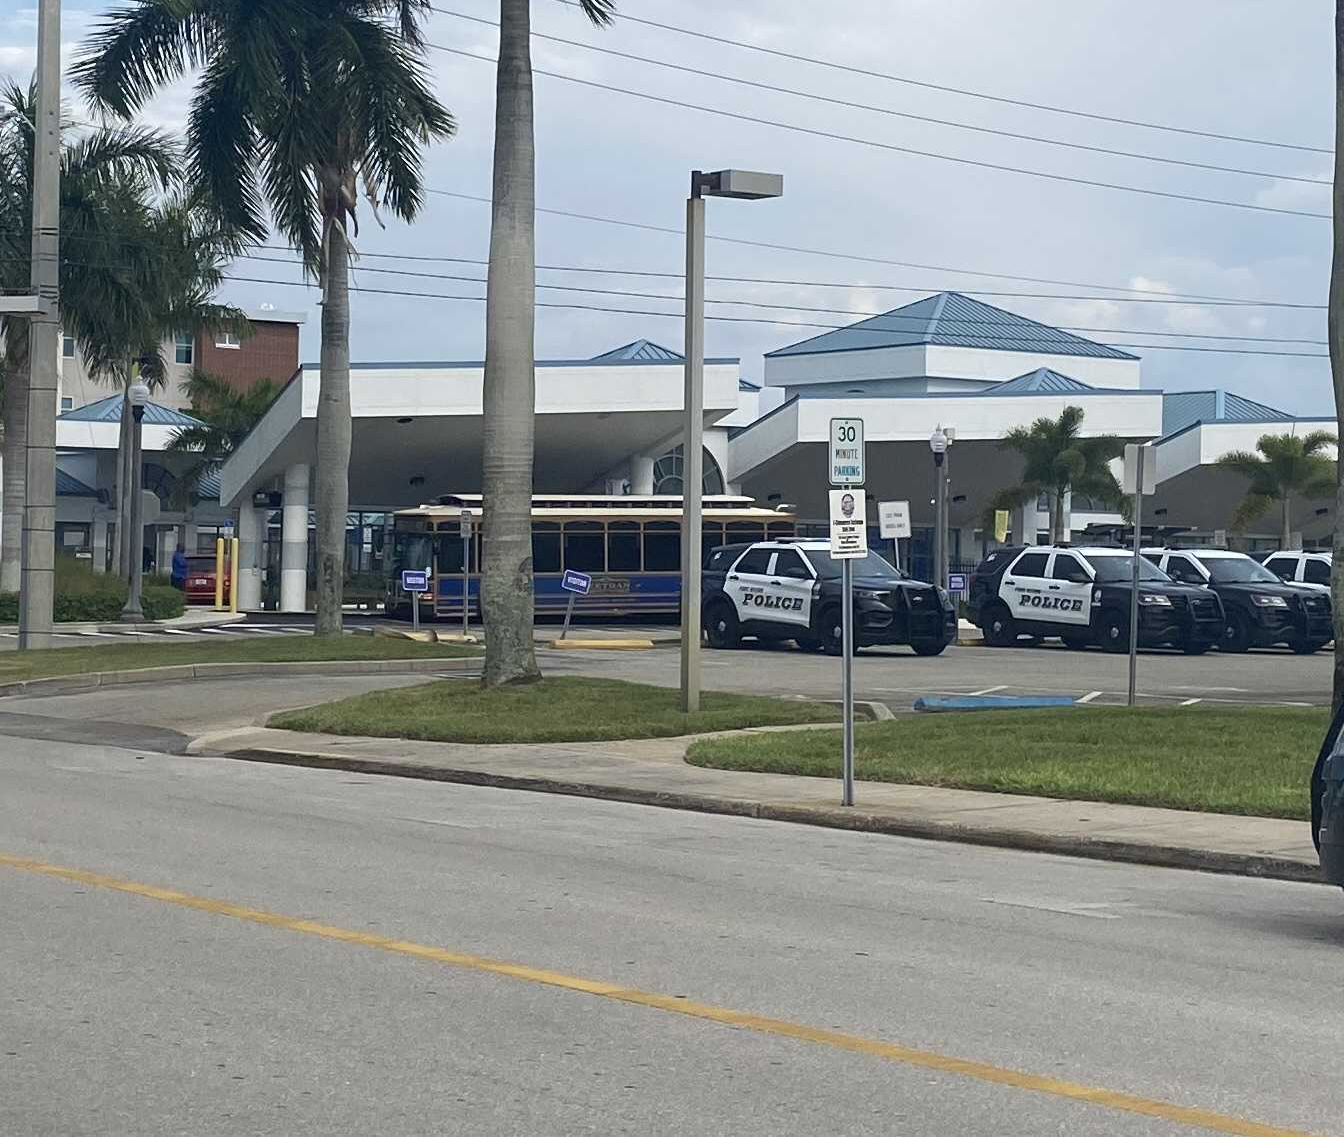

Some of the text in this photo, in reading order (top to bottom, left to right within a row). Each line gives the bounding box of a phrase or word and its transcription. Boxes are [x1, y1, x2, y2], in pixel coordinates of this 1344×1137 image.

[837, 426, 856, 442] 30
[835, 448, 858, 459] MINUTE
[833, 465, 861, 477] PARKING
[742, 593, 804, 611] POLICE
[1019, 594, 1083, 612] POLICE
